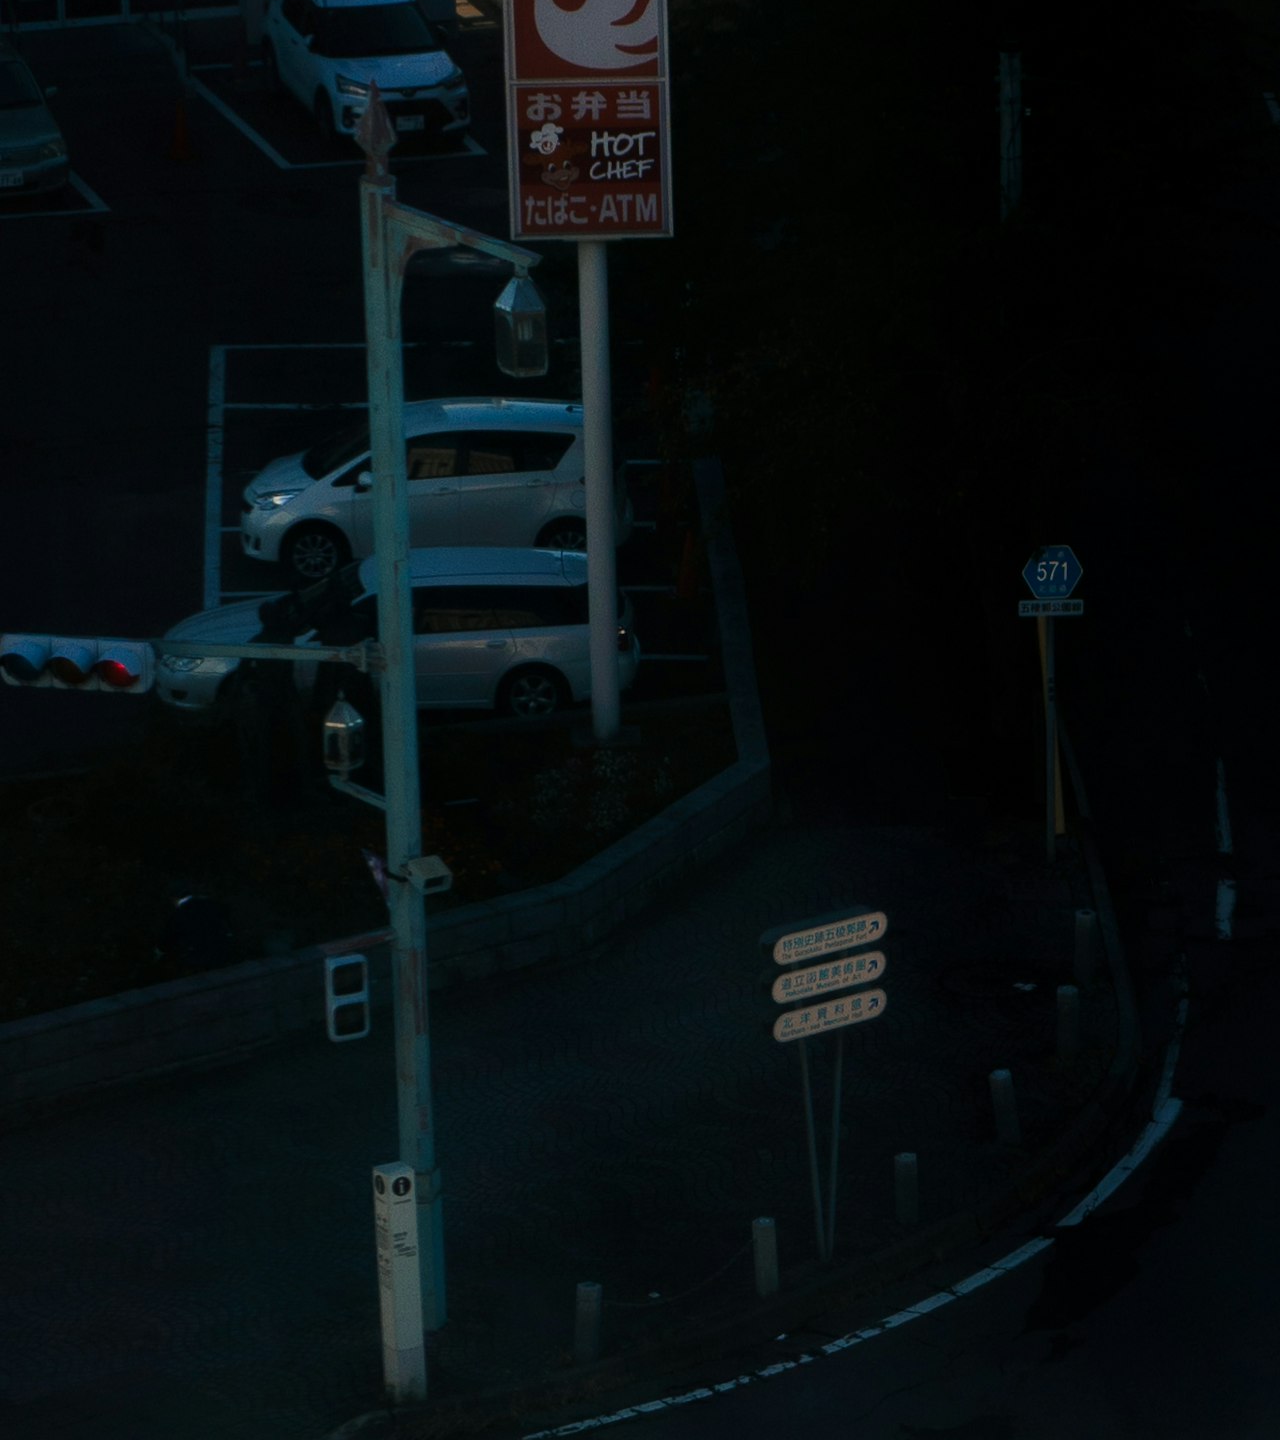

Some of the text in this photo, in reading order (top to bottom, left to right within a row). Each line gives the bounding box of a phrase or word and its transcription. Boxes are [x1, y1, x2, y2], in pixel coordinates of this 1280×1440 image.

[526, 90, 652, 121] お弁当
[590, 130, 656, 158] HOT
[589, 159, 655, 180] CHEF
[1036, 561, 1068, 582] 571
